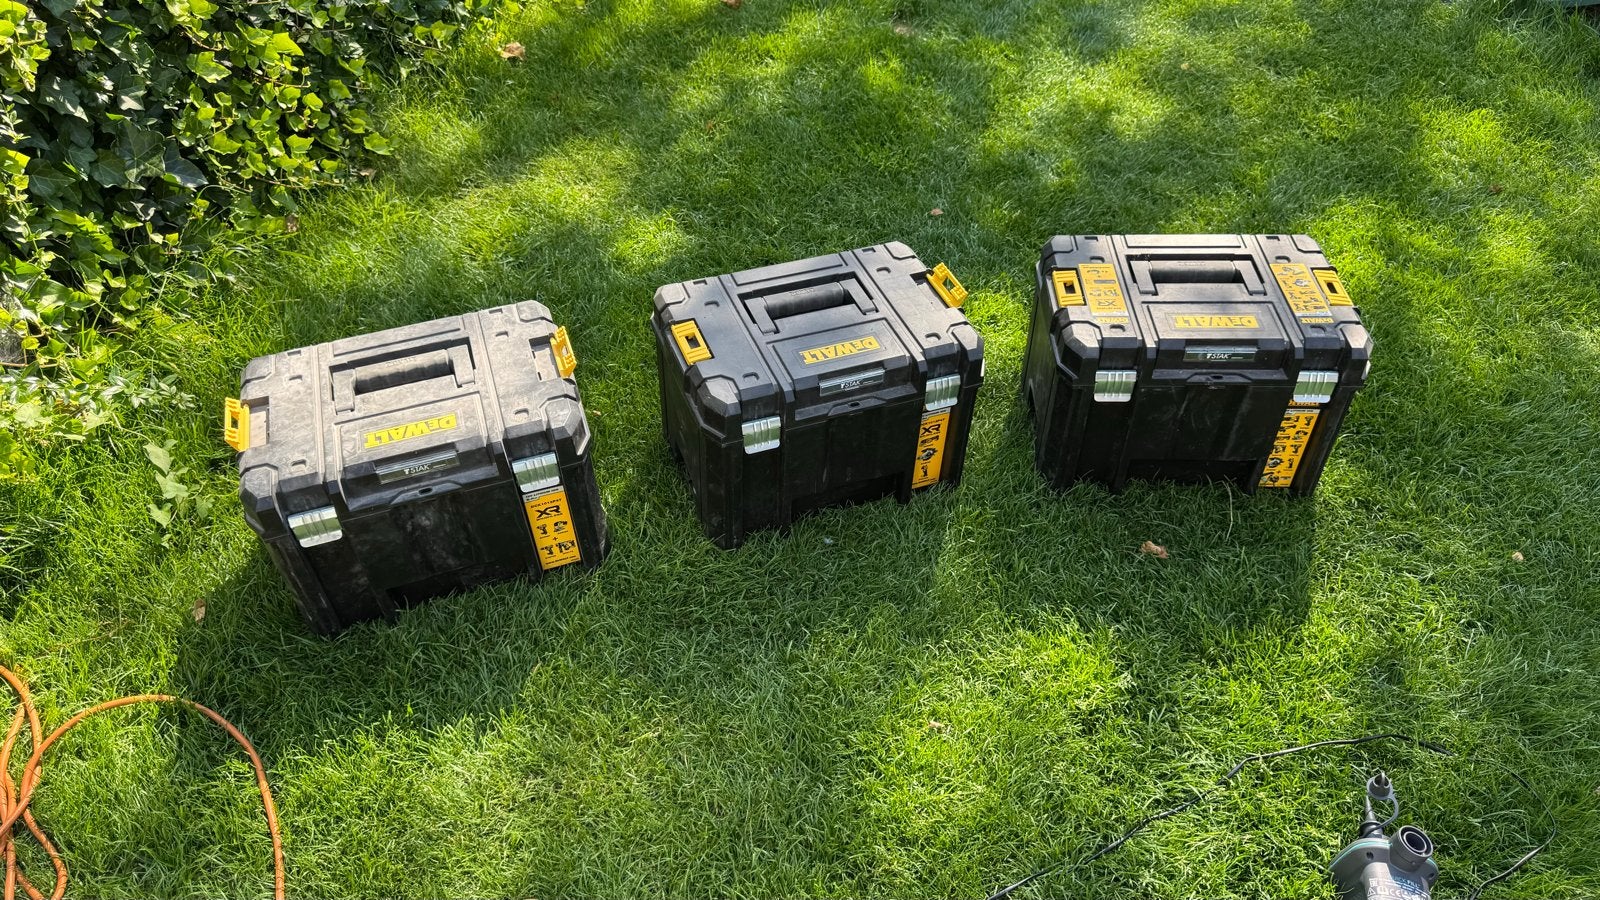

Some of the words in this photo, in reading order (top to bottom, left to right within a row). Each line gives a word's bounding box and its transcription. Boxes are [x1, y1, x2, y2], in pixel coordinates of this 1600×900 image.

[1174, 315, 1260, 328] DEWALT
[799, 336, 880, 365] DEWALT
[364, 414, 457, 449] DEWALT
[921, 423, 941, 436] XR
[535, 504, 561, 519] XR
